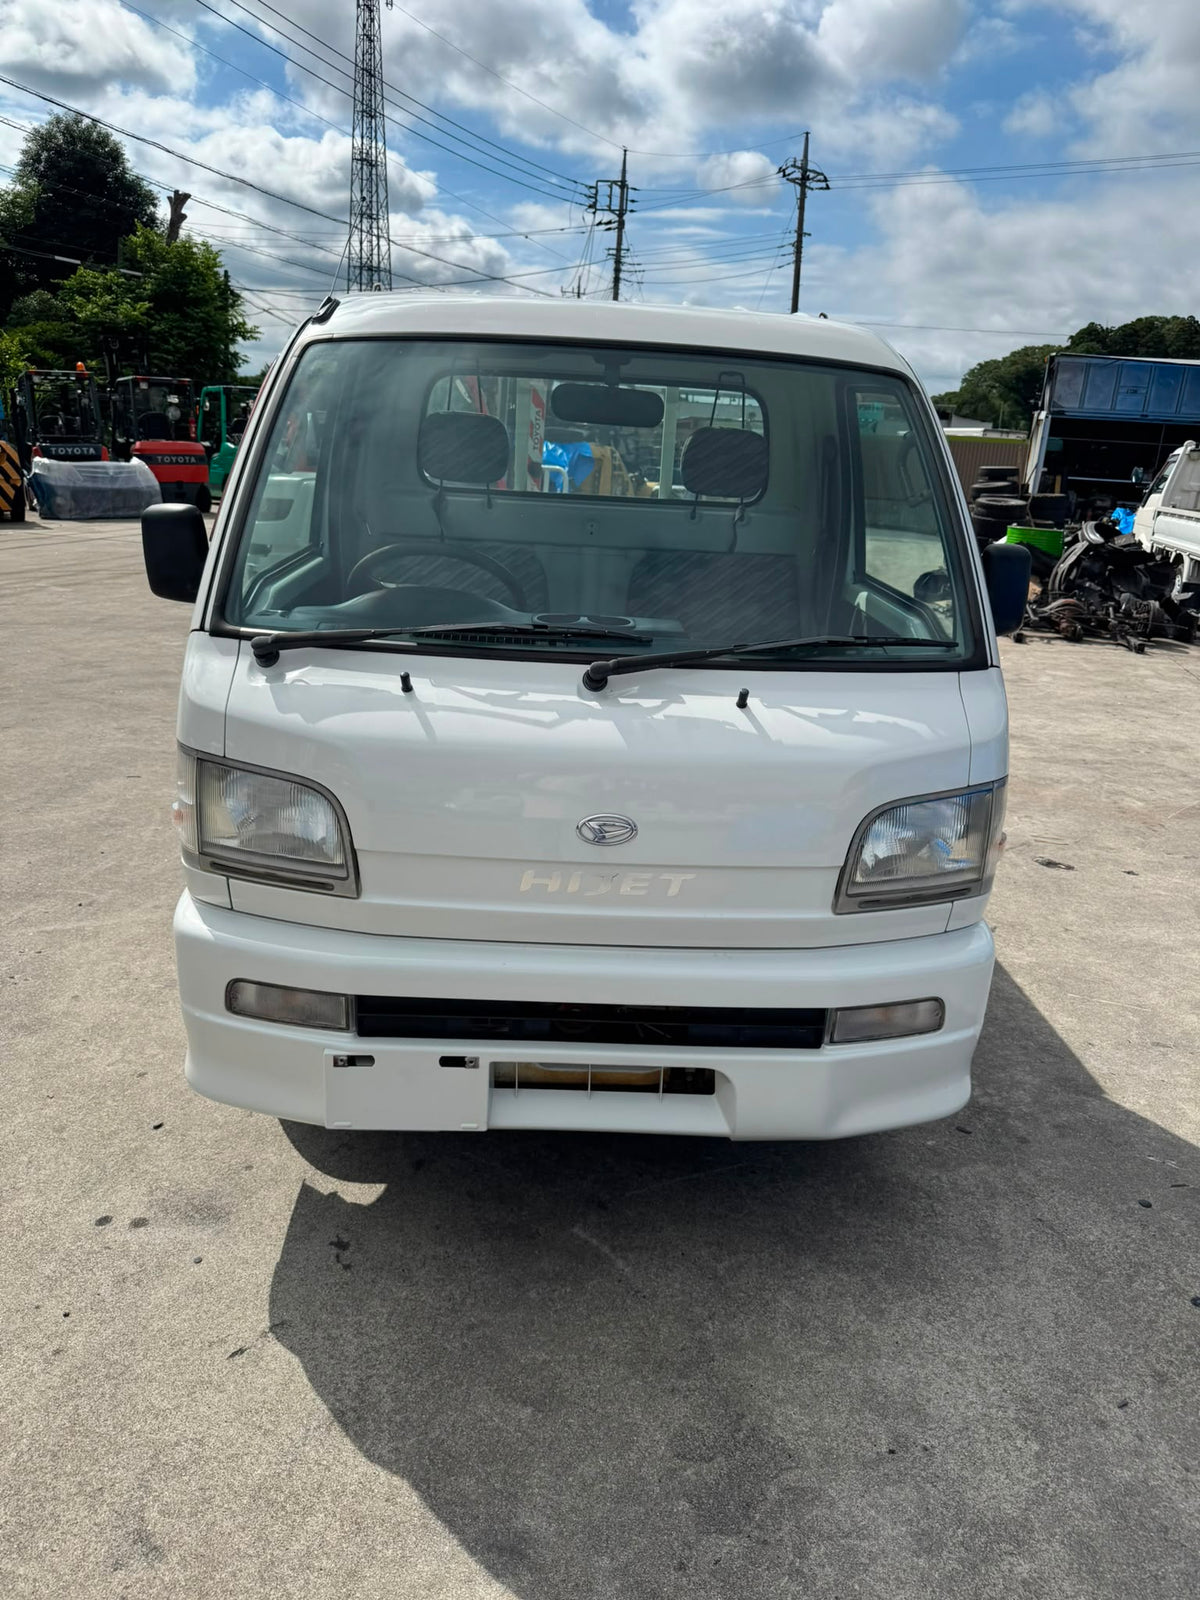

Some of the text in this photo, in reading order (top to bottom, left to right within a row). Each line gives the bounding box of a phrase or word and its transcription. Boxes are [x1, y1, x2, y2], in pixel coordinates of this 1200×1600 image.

[533, 410, 542, 450] TOYOTA
[51, 447, 96, 455] TOYOTA
[519, 870, 696, 897] HIJET
